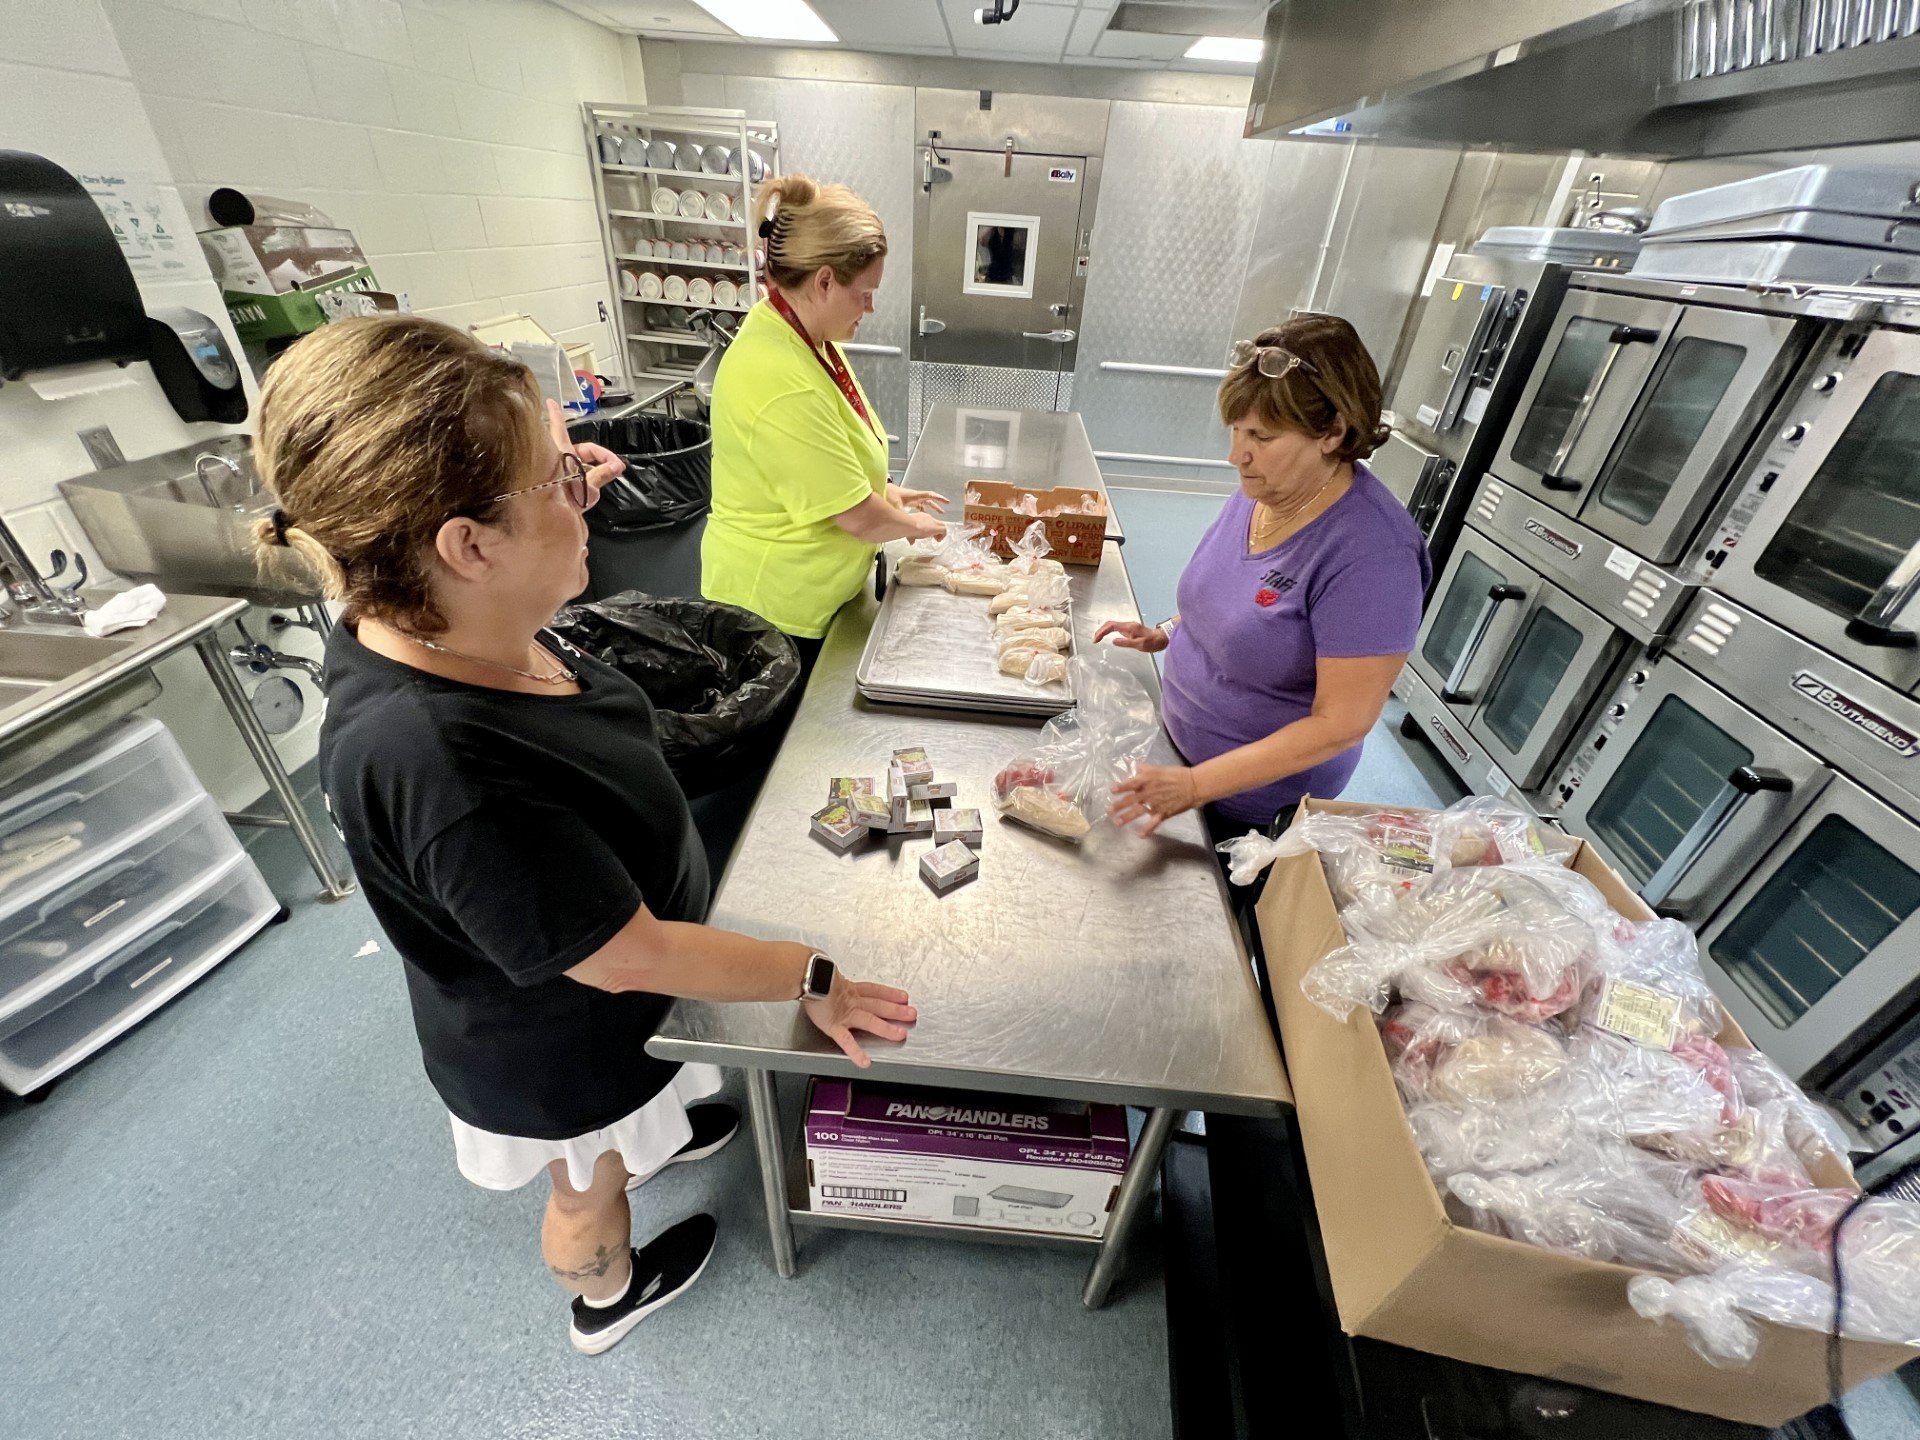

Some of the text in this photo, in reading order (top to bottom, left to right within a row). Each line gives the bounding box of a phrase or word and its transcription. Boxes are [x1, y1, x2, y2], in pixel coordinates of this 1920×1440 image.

[1052, 170, 1074, 180] Bally
[228, 304, 267, 325] NAVE
[970, 512, 1002, 523] GRAPE
[1066, 521, 1104, 530] LIPMAN
[1260, 569, 1297, 592] STAFF
[1817, 688, 1909, 748] SOUTHBEND
[885, 1102, 1049, 1130] PAN HANDLERS
[814, 1131, 839, 1141] 100
[993, 1134, 1009, 1142] Pan
[1019, 1147, 1040, 1155] OPL
[1105, 1155, 1125, 1163] Pan
[1026, 1154, 1062, 1162] Reorder
[850, 1201, 903, 1210] HANDLERS
